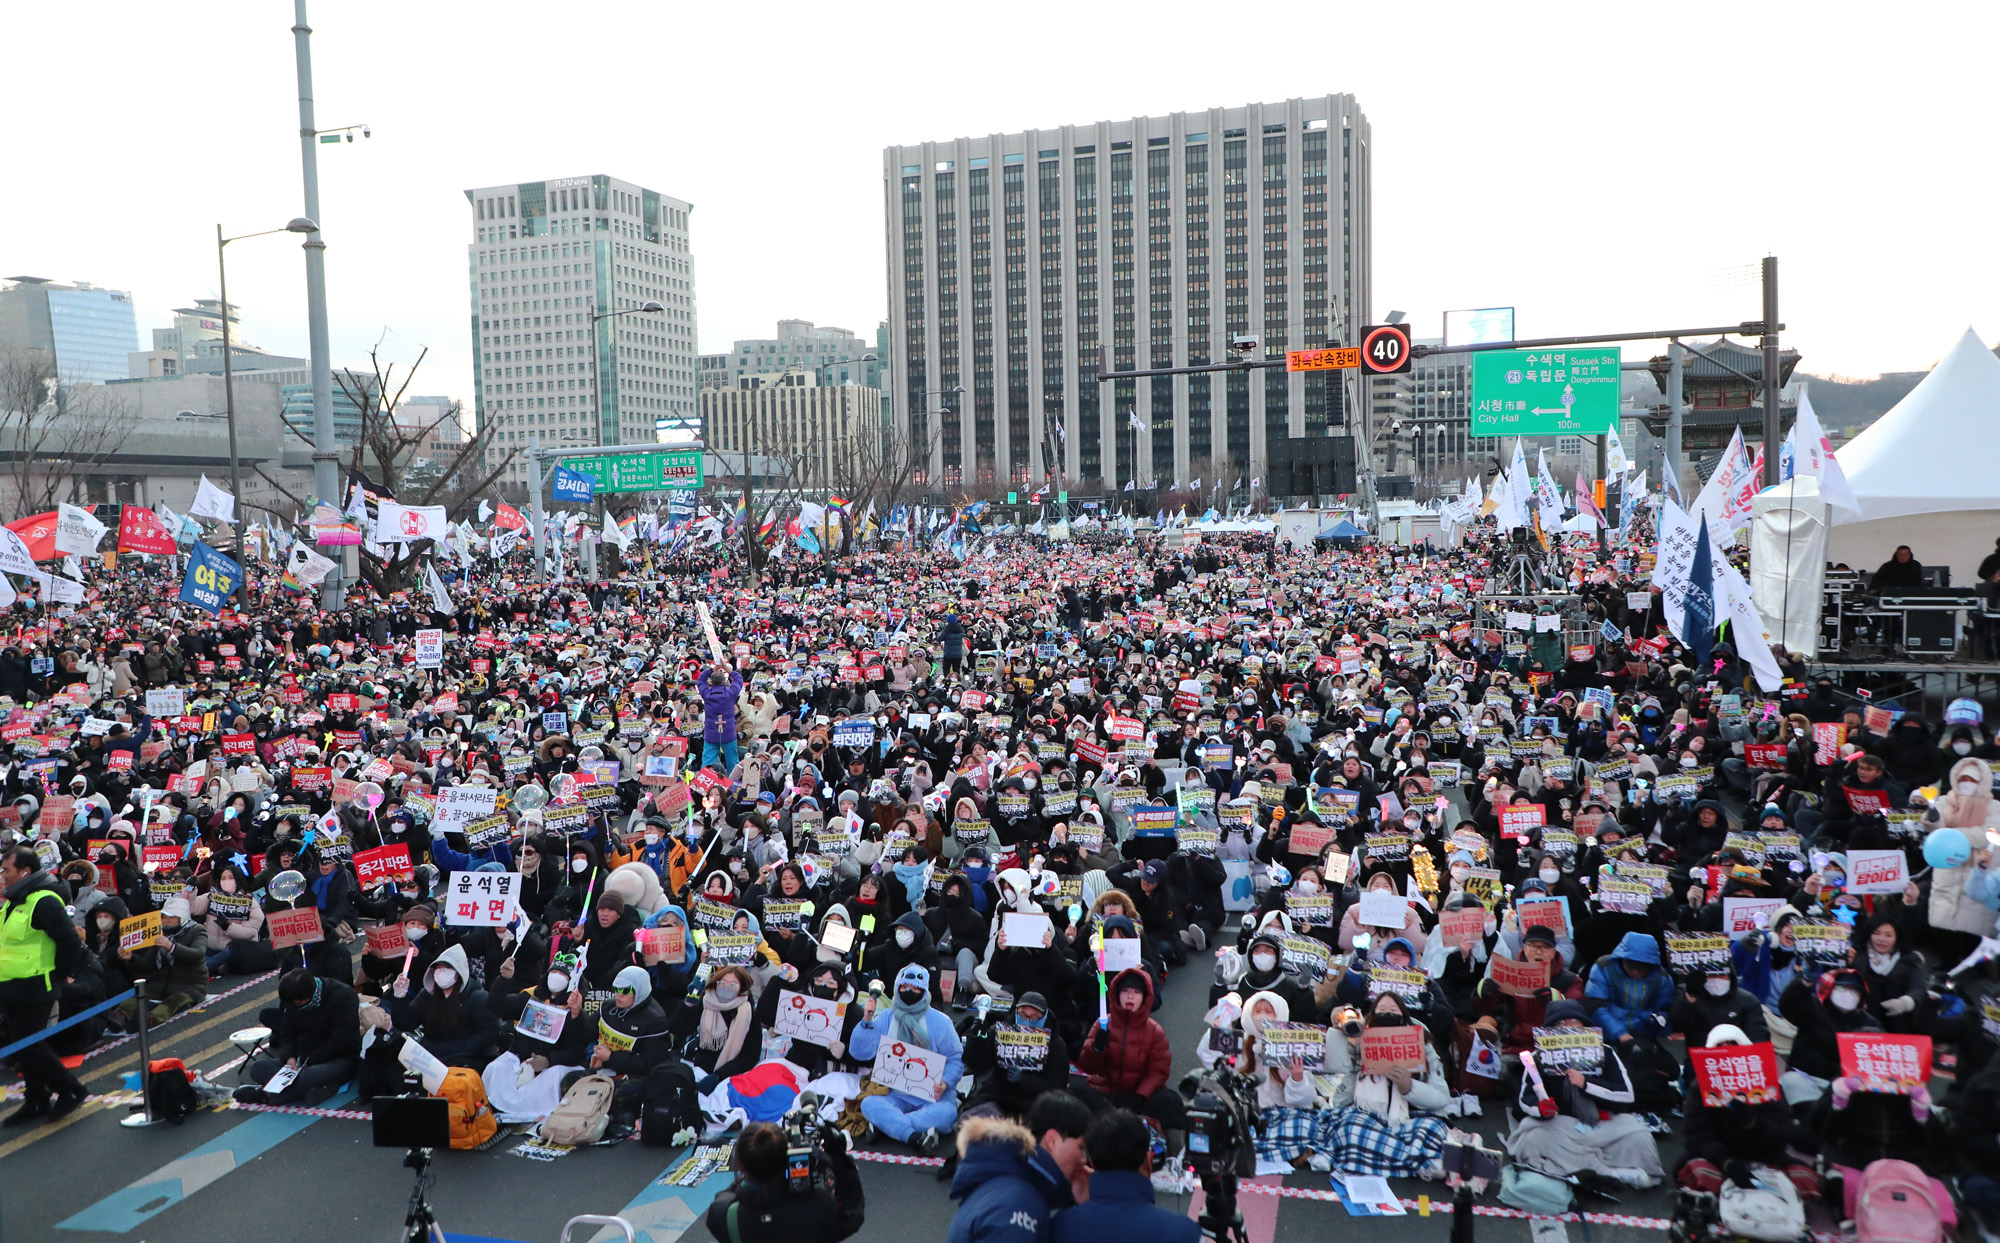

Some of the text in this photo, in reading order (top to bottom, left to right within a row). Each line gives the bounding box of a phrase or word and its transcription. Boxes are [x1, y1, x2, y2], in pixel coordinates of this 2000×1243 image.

[554, 179, 574, 187] 외교부
[1374, 339, 1398, 359] 40
[1291, 351, 1357, 368] 과속단속장비
[1526, 354, 1615, 366] 수색역 Susaek Stn
[1571, 367, 1599, 375] 獨立門
[1510, 370, 1616, 384] 21 독립문 Dongnimmun
[1478, 400, 1502, 411] 시청
[1478, 414, 1519, 423] City Hall
[1557, 420, 1580, 429] 100m
[621, 458, 646, 466] 수색역
[662, 457, 695, 465] 삼청터널
[417, 652, 440, 660] 구속하라
[2, 726, 31, 737] 즉각 파면
[223, 739, 255, 750] 즉각 파면
[833, 733, 874, 746] 퇴진하라
[116, 756, 132, 766] 파면
[1751, 750, 1778, 762] 탄핵
[697, 773, 712, 788] 즉각
[439, 789, 494, 803] 총을 쏴서라도
[1502, 812, 1542, 823] 윤석열을
[358, 856, 410, 875] 즉각 파면
[457, 876, 511, 894] 윤석열
[1469, 878, 1490, 887] HA
[1604, 883, 1650, 894] 내란수괴 윤석열
[213, 895, 231, 904] 내란수괴
[1288, 899, 1308, 907] 내란수괴
[457, 899, 505, 921] 파면
[698, 903, 717, 913] 내란수괴
[768, 904, 785, 912] 내란수괴
[273, 921, 319, 938] 해체하라
[1442, 922, 1483, 936] 해체하라
[121, 924, 162, 949] 파면하라
[712, 937, 733, 946] 내란수괴
[1287, 941, 1309, 953] 내란수괴
[1671, 940, 1724, 950] 내란수괴 윤석열
[1374, 970, 1424, 985] 내란수괴 윤석열
[1000, 1032, 1044, 1044] 내란수괴 윤석열
[1268, 1031, 1320, 1041] 내란수괴 윤석열
[1392, 1034, 1419, 1044] 국민의힘
[1541, 1035, 1597, 1046] 내란수괴 윤석열
[1364, 1046, 1422, 1061] 해체하라
[1853, 1042, 1920, 1062] 윤석열을
[1704, 1056, 1763, 1074] 윤석열을
[1856, 1059, 1922, 1080] 체포하라
[1708, 1072, 1767, 1092] 체포하라
